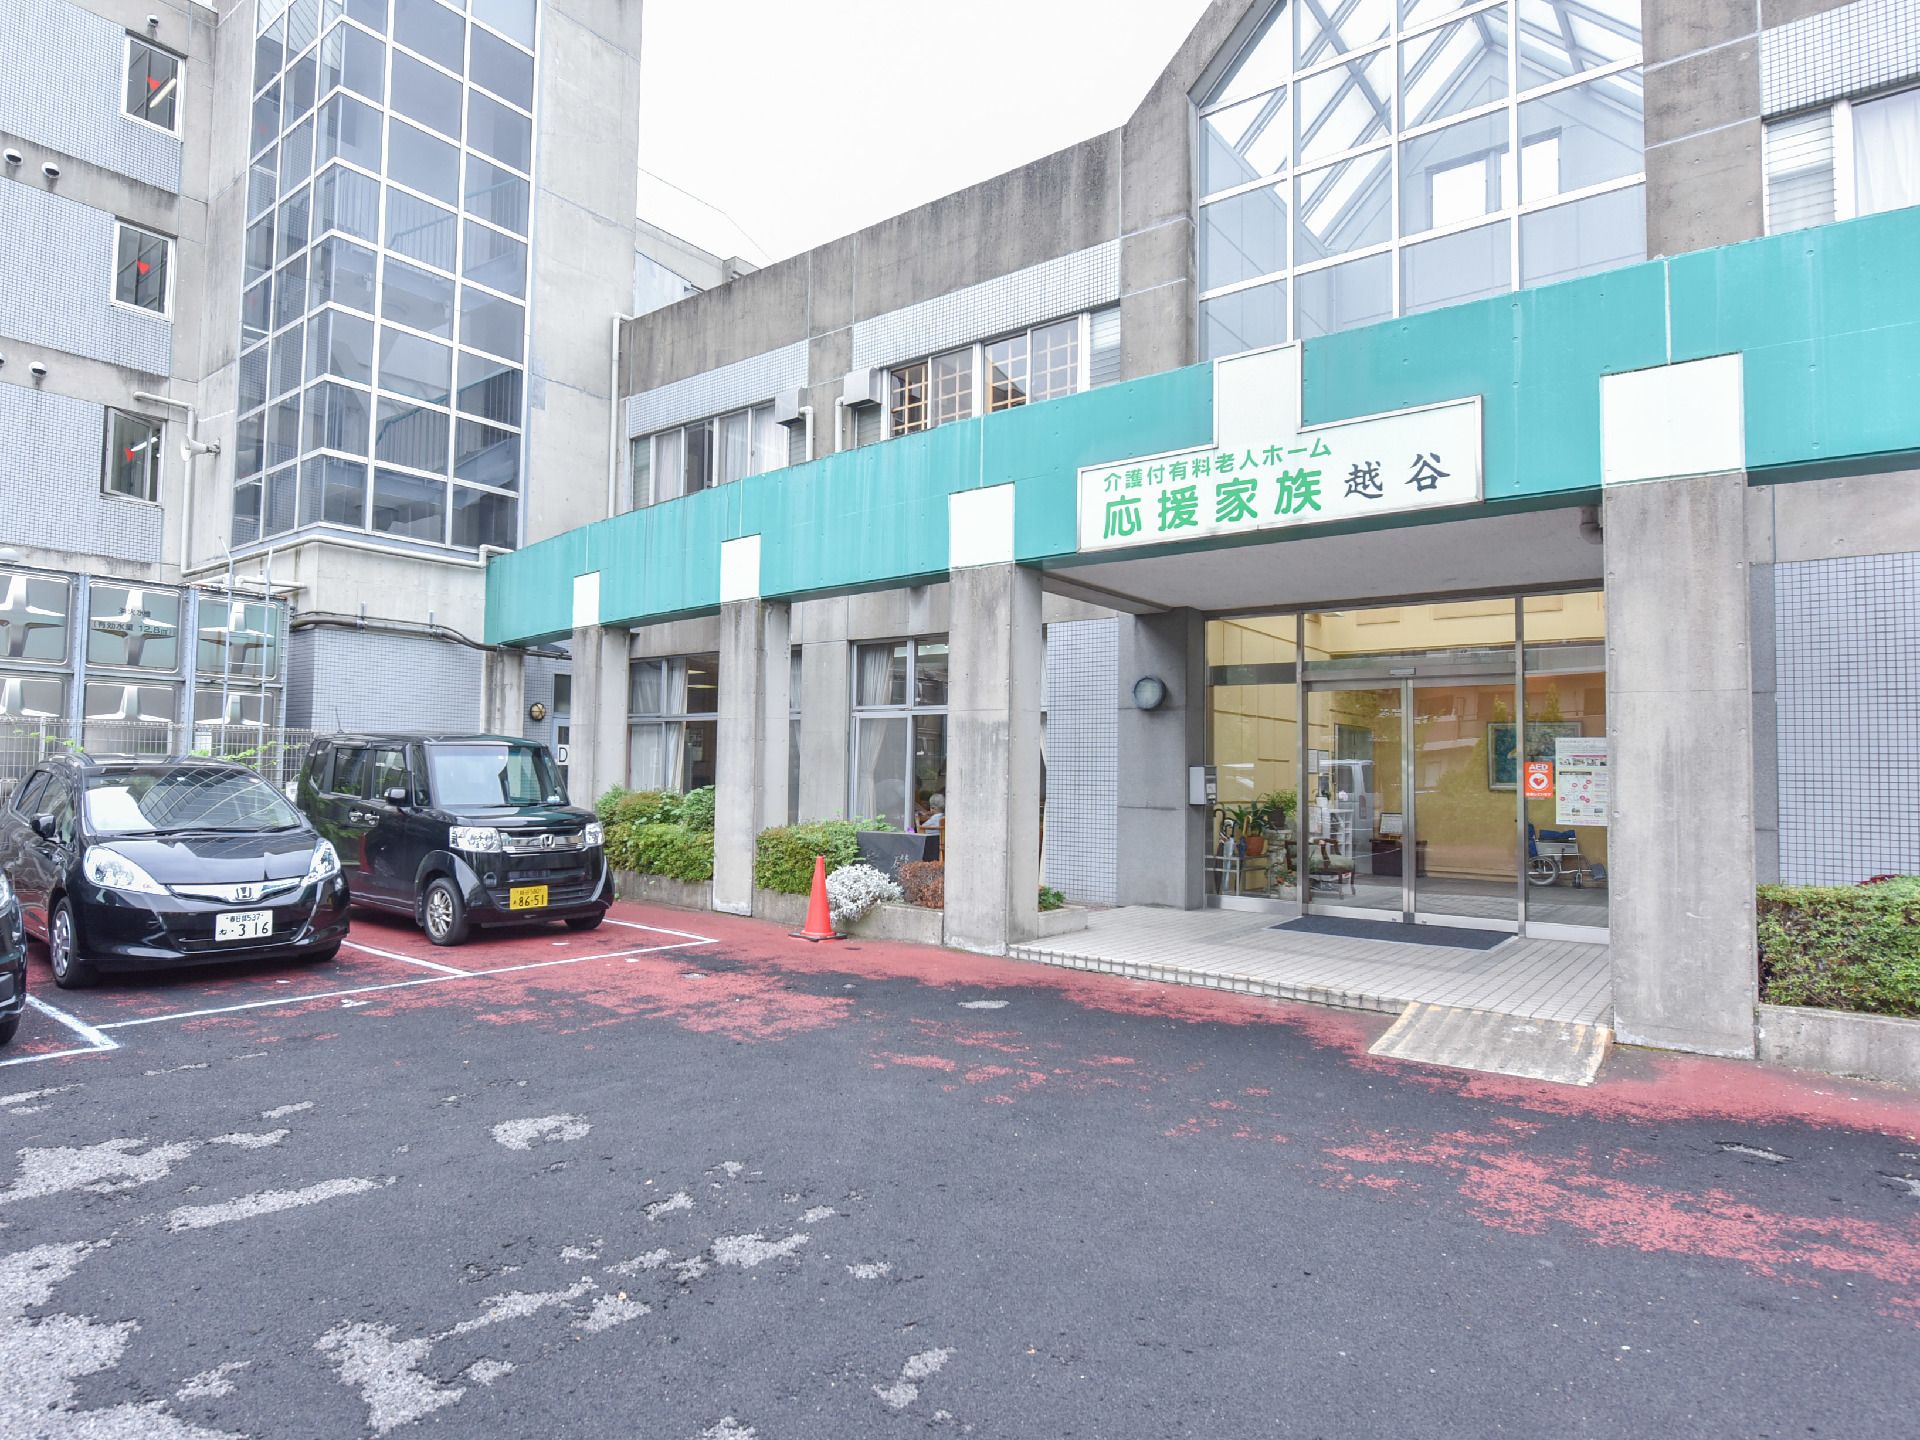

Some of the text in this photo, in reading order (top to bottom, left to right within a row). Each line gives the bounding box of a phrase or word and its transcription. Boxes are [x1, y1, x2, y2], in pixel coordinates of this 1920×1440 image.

[1103, 437, 1332, 493] 介護付有料老人ホーム
[1103, 452, 1451, 540] 応援家族 越谷
[558, 747, 568, 763] D
[1528, 763, 1548, 771] AED
